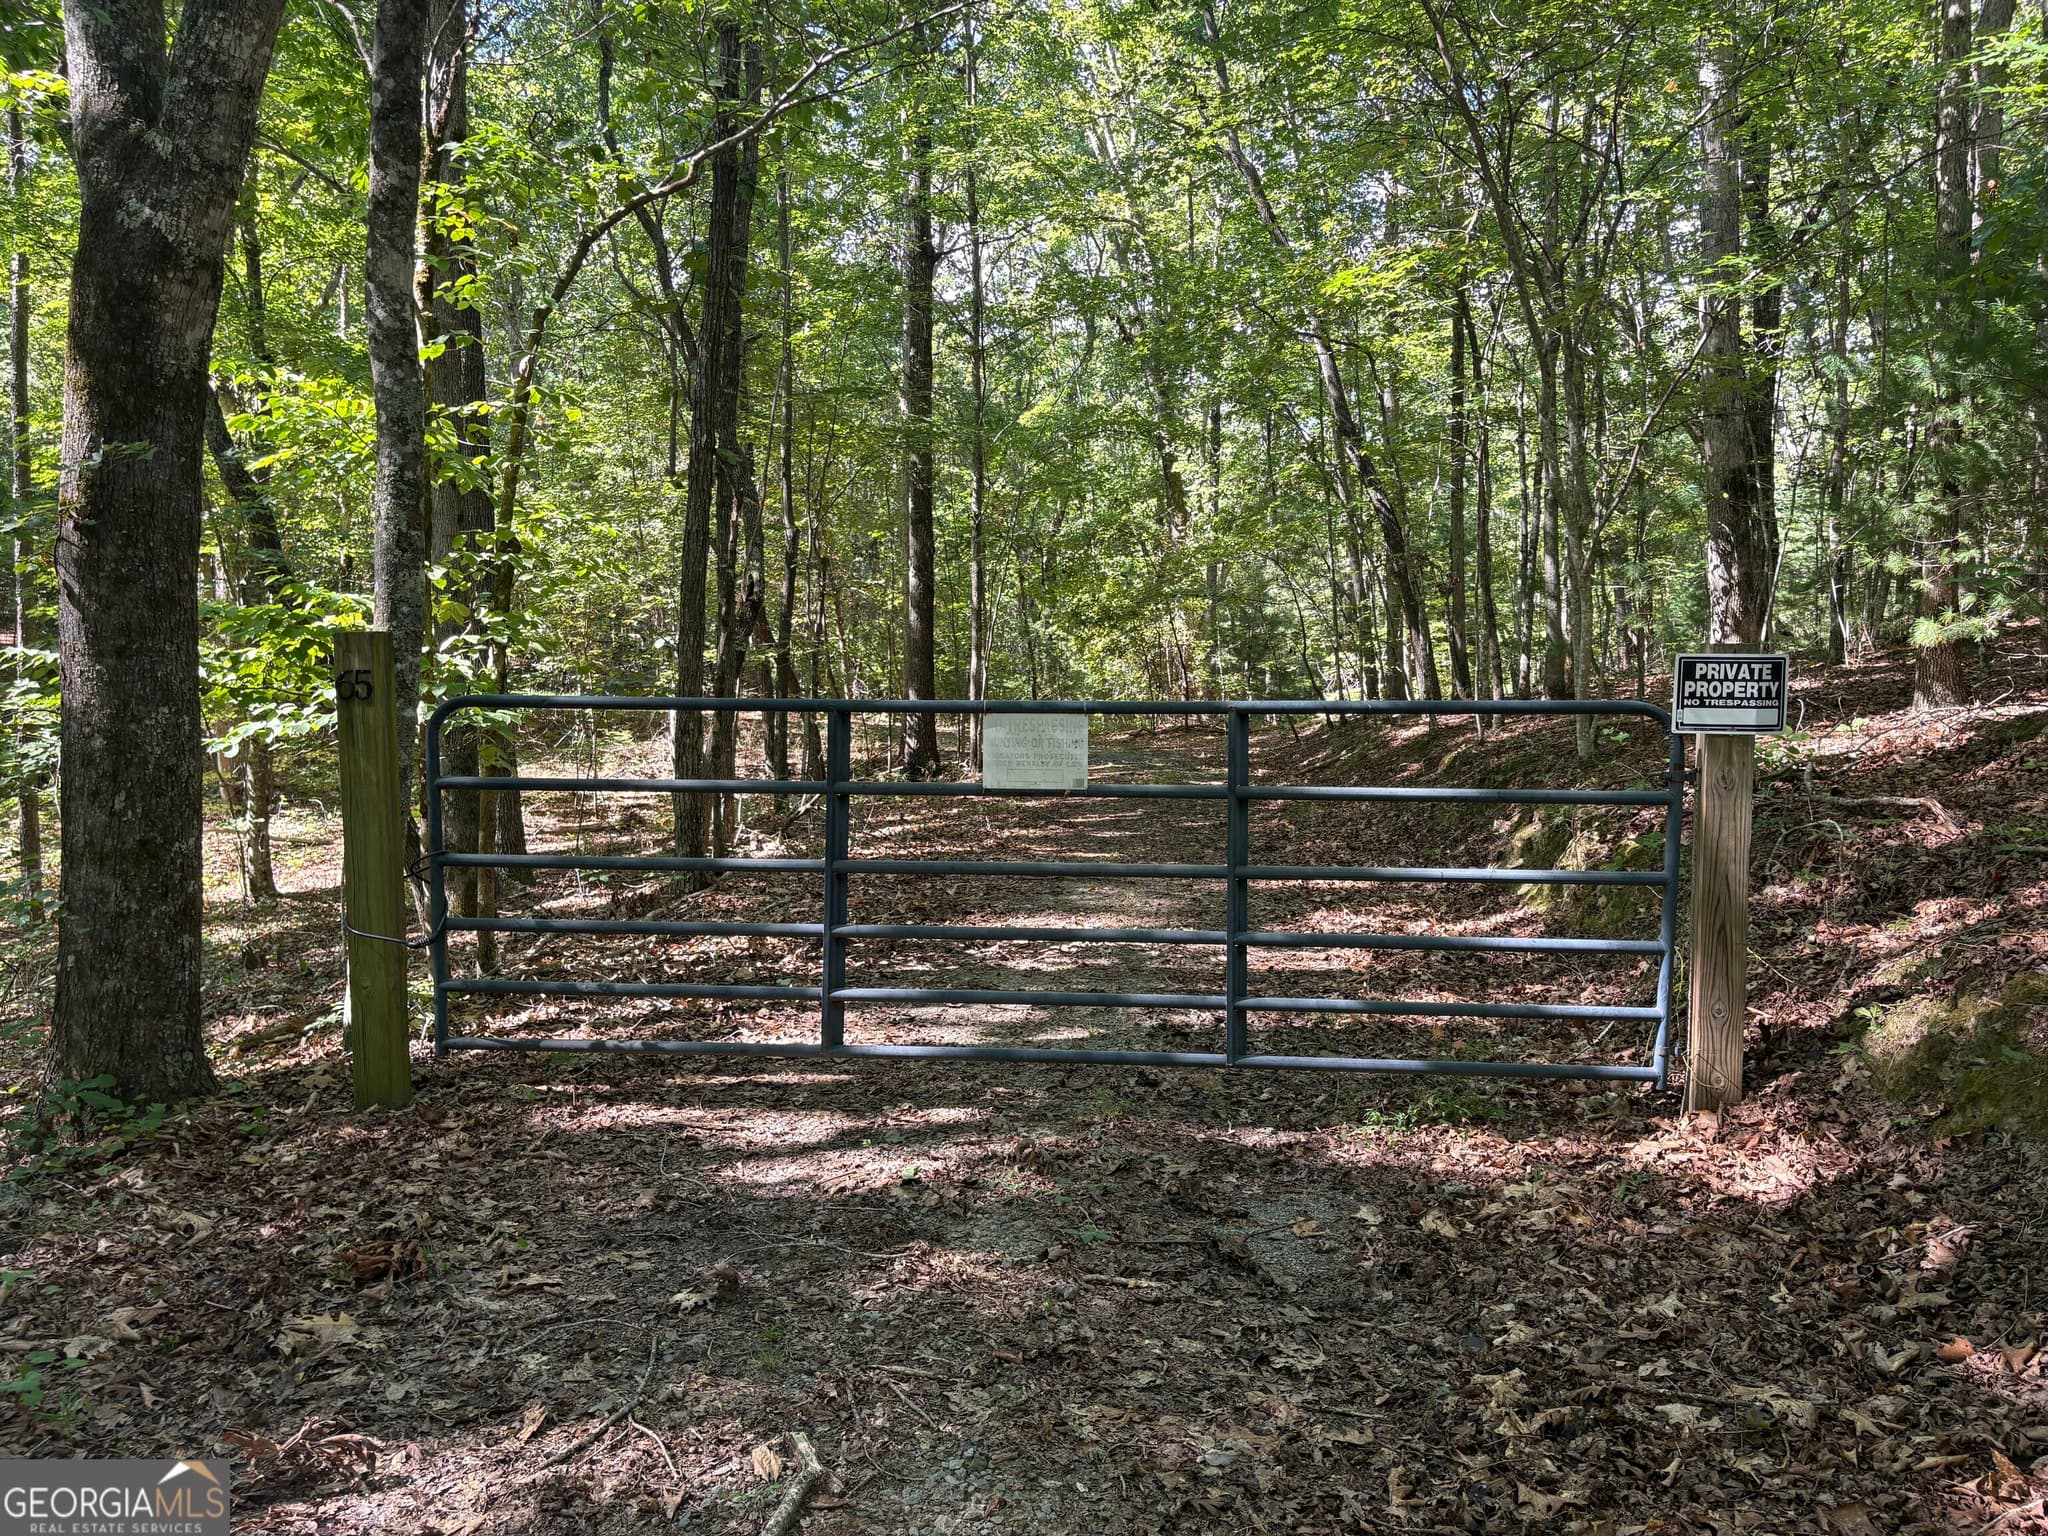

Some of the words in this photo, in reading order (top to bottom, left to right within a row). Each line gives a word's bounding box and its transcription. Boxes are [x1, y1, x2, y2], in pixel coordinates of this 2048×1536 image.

[1695, 663, 1773, 680] PRIVATE
[335, 669, 373, 700] 65
[1684, 680, 1780, 698] PROPERTY
[1683, 698, 1700, 706] NO
[1704, 698, 1779, 707] TRESPASSING
